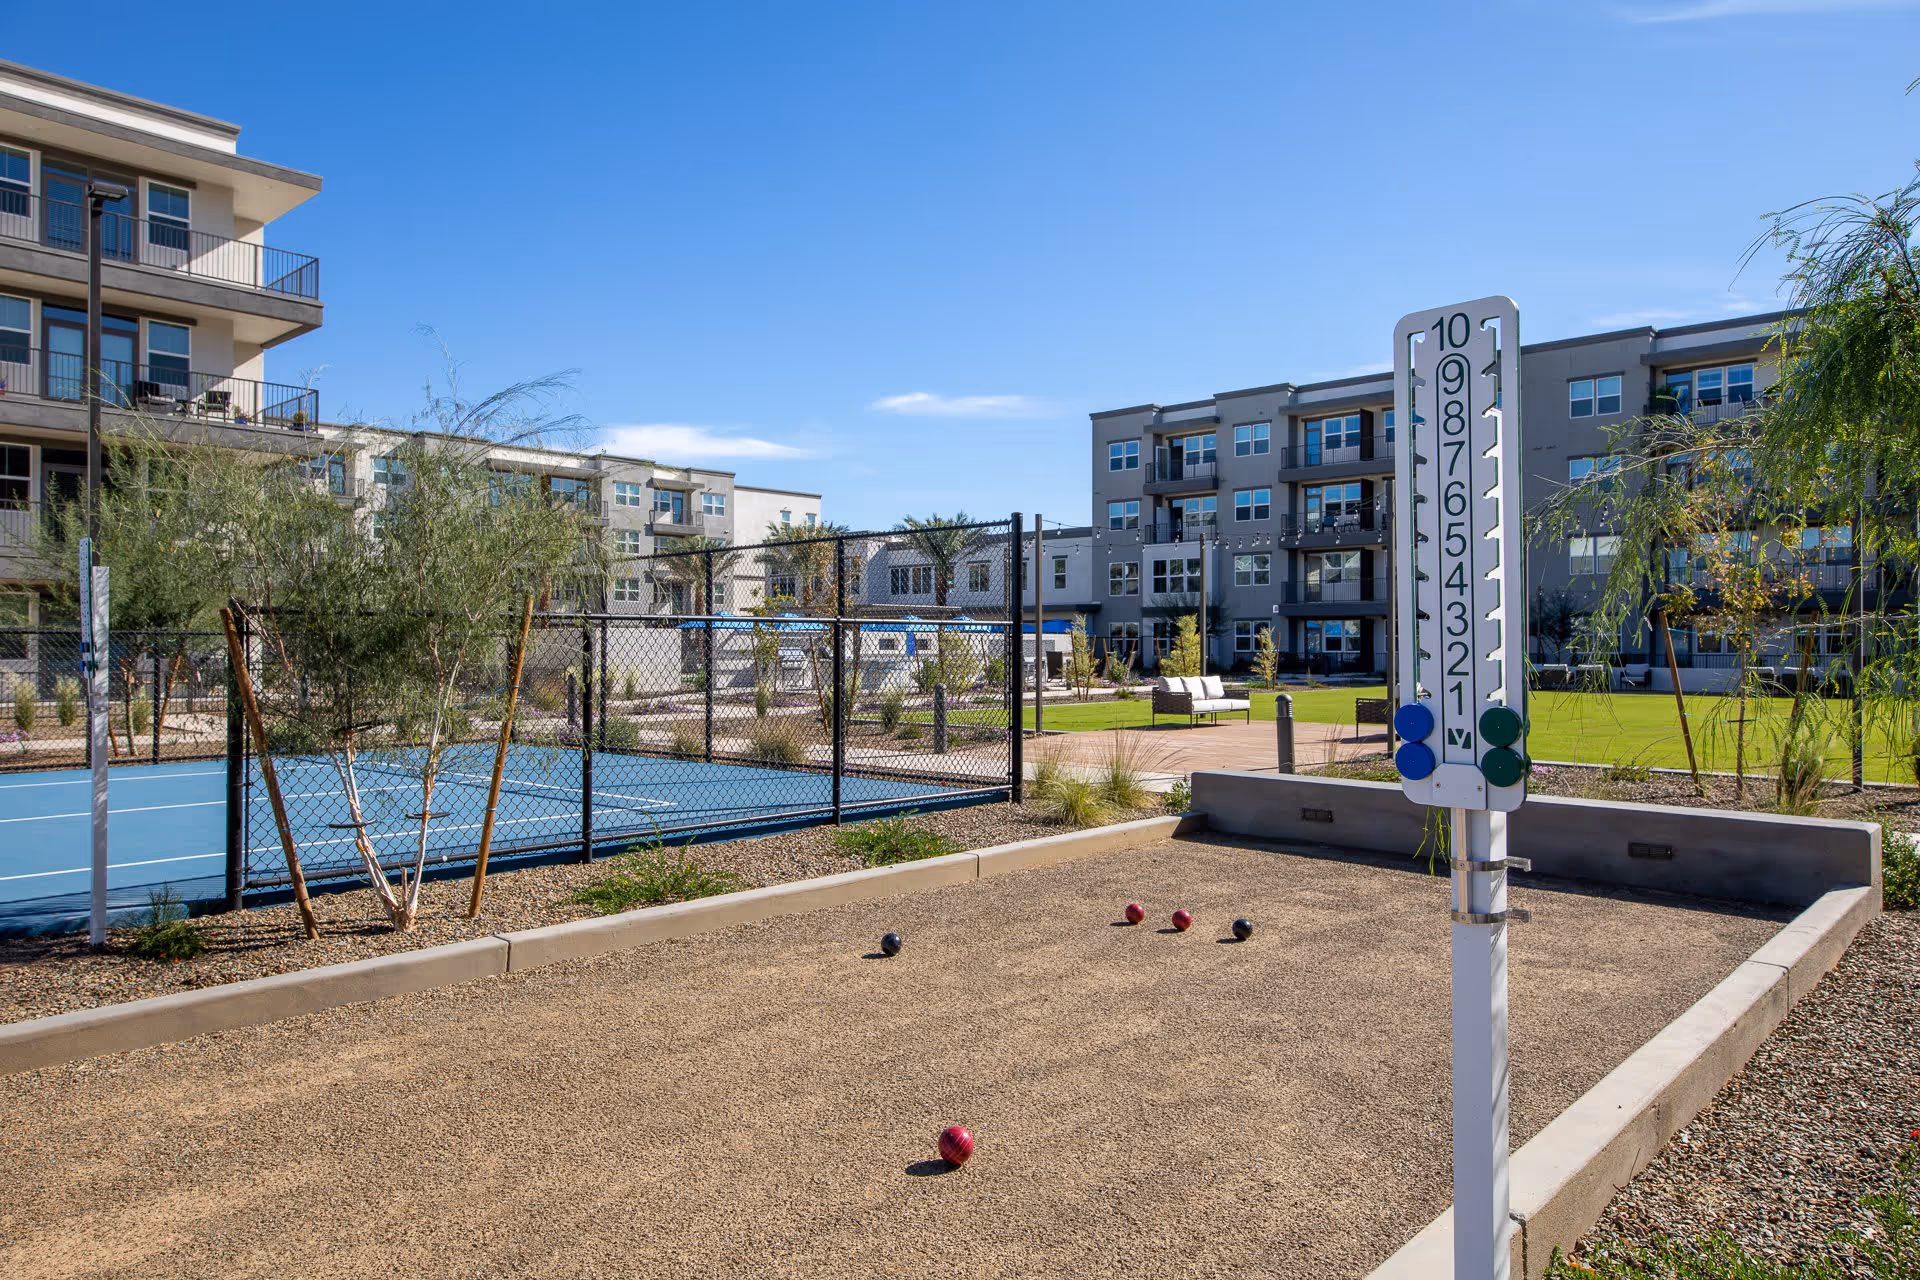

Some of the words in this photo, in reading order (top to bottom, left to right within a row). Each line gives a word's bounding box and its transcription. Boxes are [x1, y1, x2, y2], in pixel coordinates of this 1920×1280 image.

[1431, 312, 1470, 351] 10
[1442, 359, 1464, 395] 9
[1443, 400, 1465, 435] 8
[1443, 440, 1465, 476] 7
[1444, 481, 1466, 516] 6
[1445, 522, 1467, 557] 5
[1445, 561, 1468, 596] 4
[1447, 601, 1469, 636] 3
[1447, 641, 1469, 676] 2
[1449, 681, 1463, 715] 1
